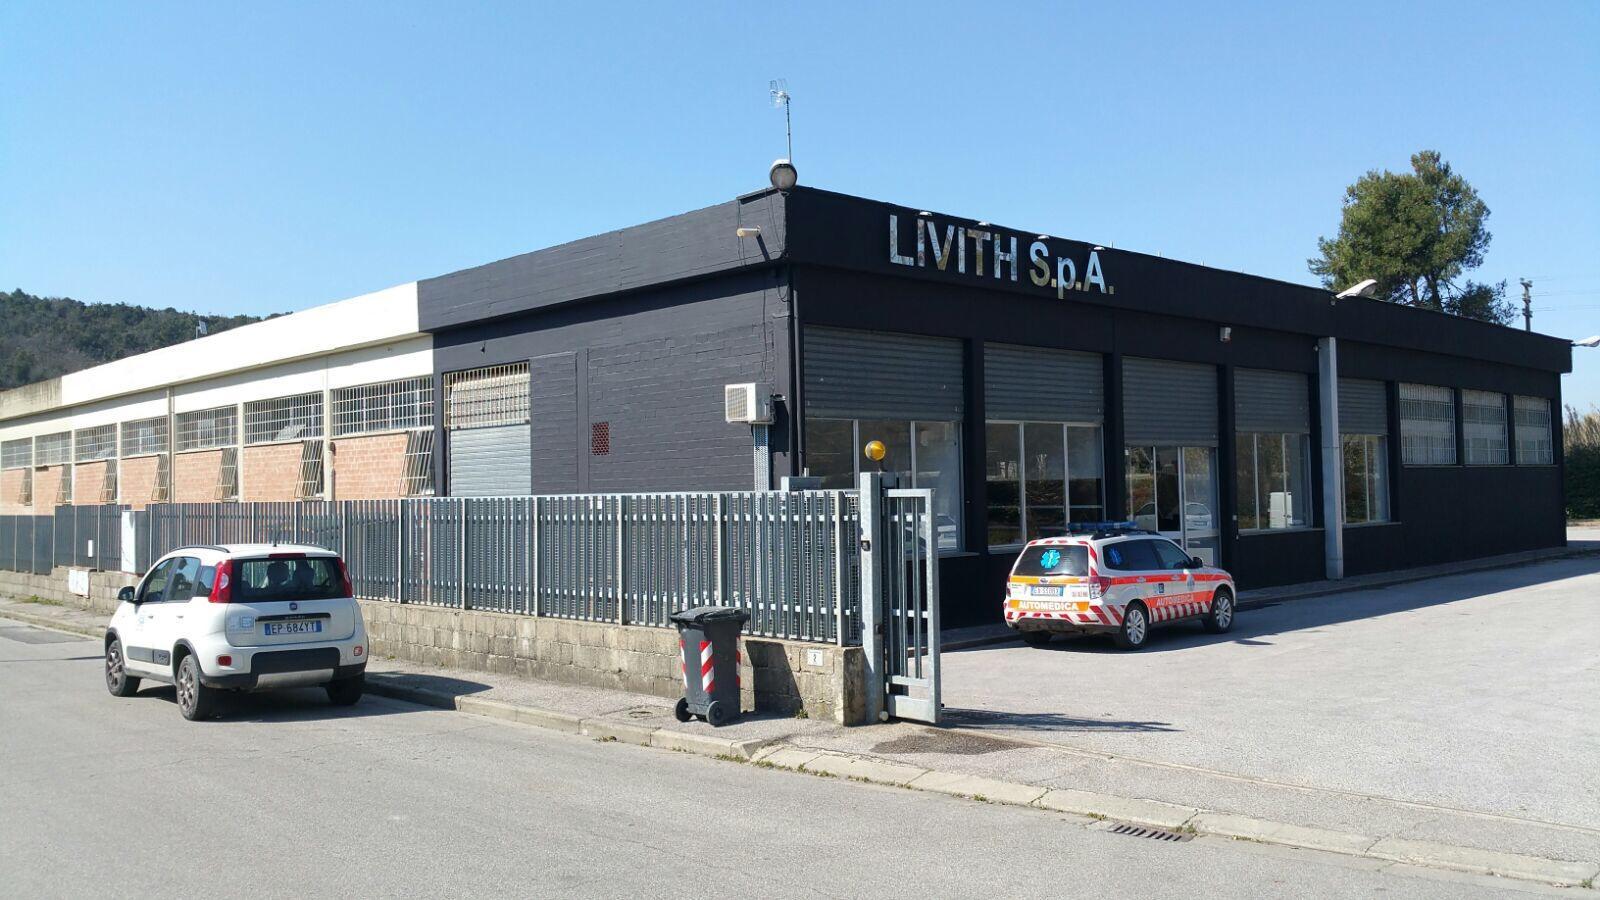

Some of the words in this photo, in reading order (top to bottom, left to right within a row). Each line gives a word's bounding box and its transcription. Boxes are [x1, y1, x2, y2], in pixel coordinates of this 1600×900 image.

[889, 214, 1018, 281] LIVITH
[1029, 241, 1114, 299] S.p.A.
[1156, 593, 1194, 606] AUTOMEDICA
[1018, 601, 1079, 611] AUTOMEDICA
[272, 623, 283, 634] EP
